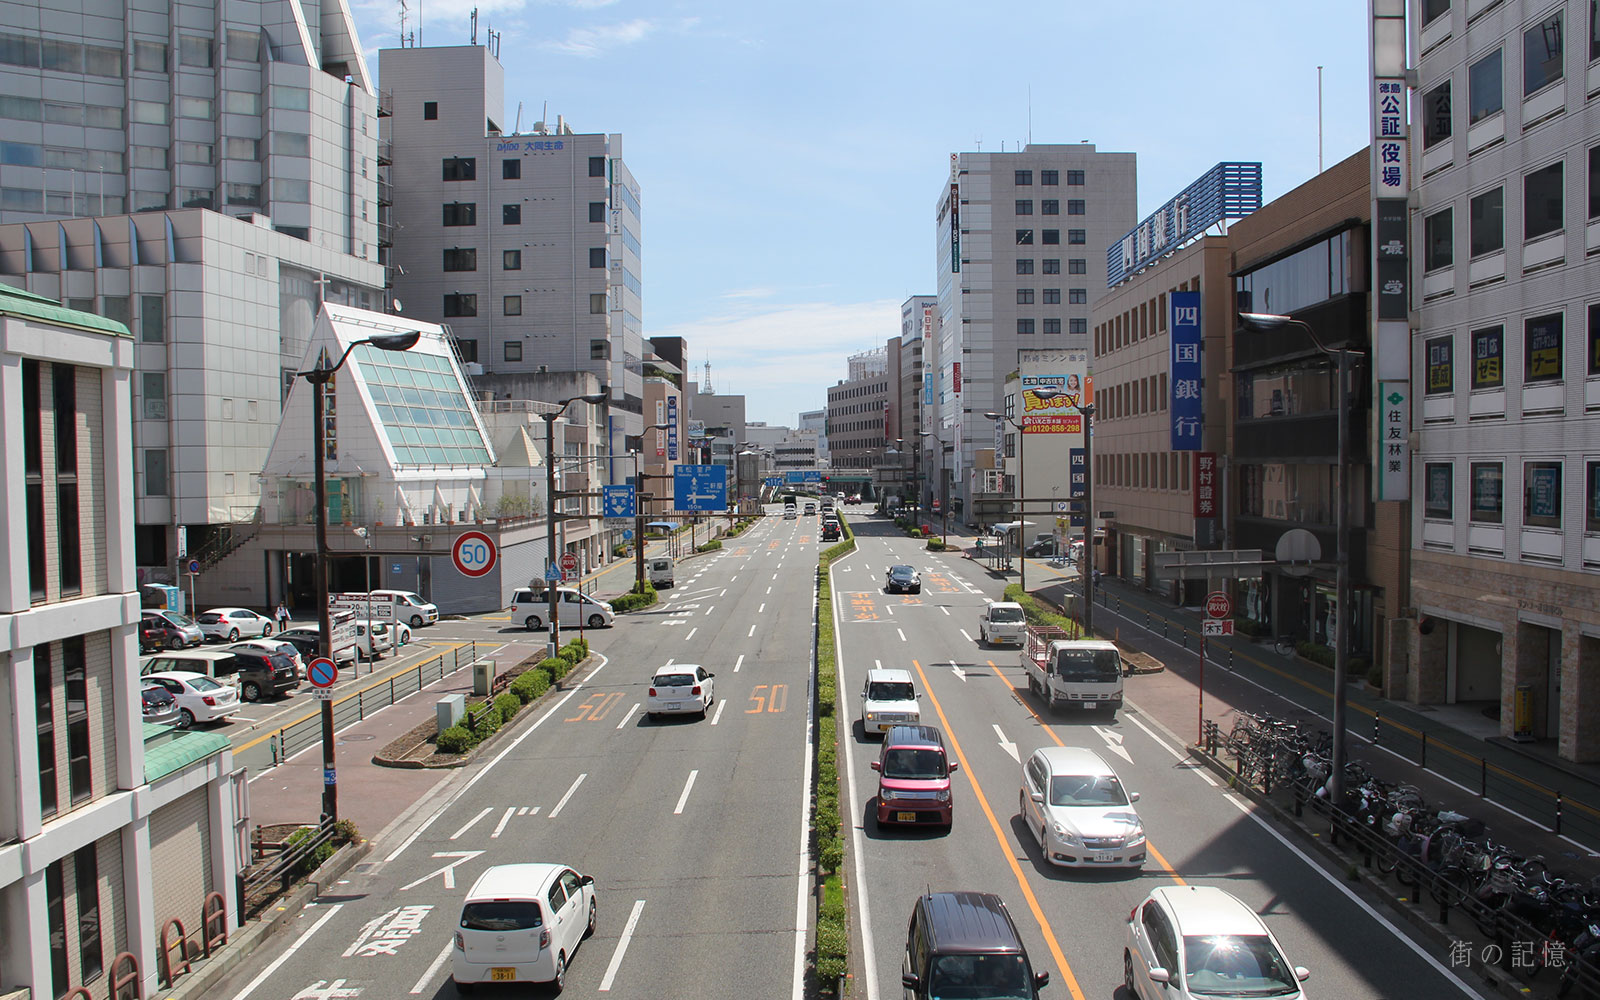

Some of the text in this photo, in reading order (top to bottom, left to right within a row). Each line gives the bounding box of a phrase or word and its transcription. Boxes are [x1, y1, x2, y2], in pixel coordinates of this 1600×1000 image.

[1379, 82, 1401, 93] 徳島
[1380, 95, 1401, 187] 公証役場
[1122, 194, 1189, 270] 四国銀行
[1175, 306, 1200, 437] 四国銀行
[1388, 410, 1402, 473] 住友林業
[462, 544, 486, 564] 50
[1206, 624, 1222, 634] 木下
[564, 691, 626, 722] 50
[744, 683, 788, 714] 50
